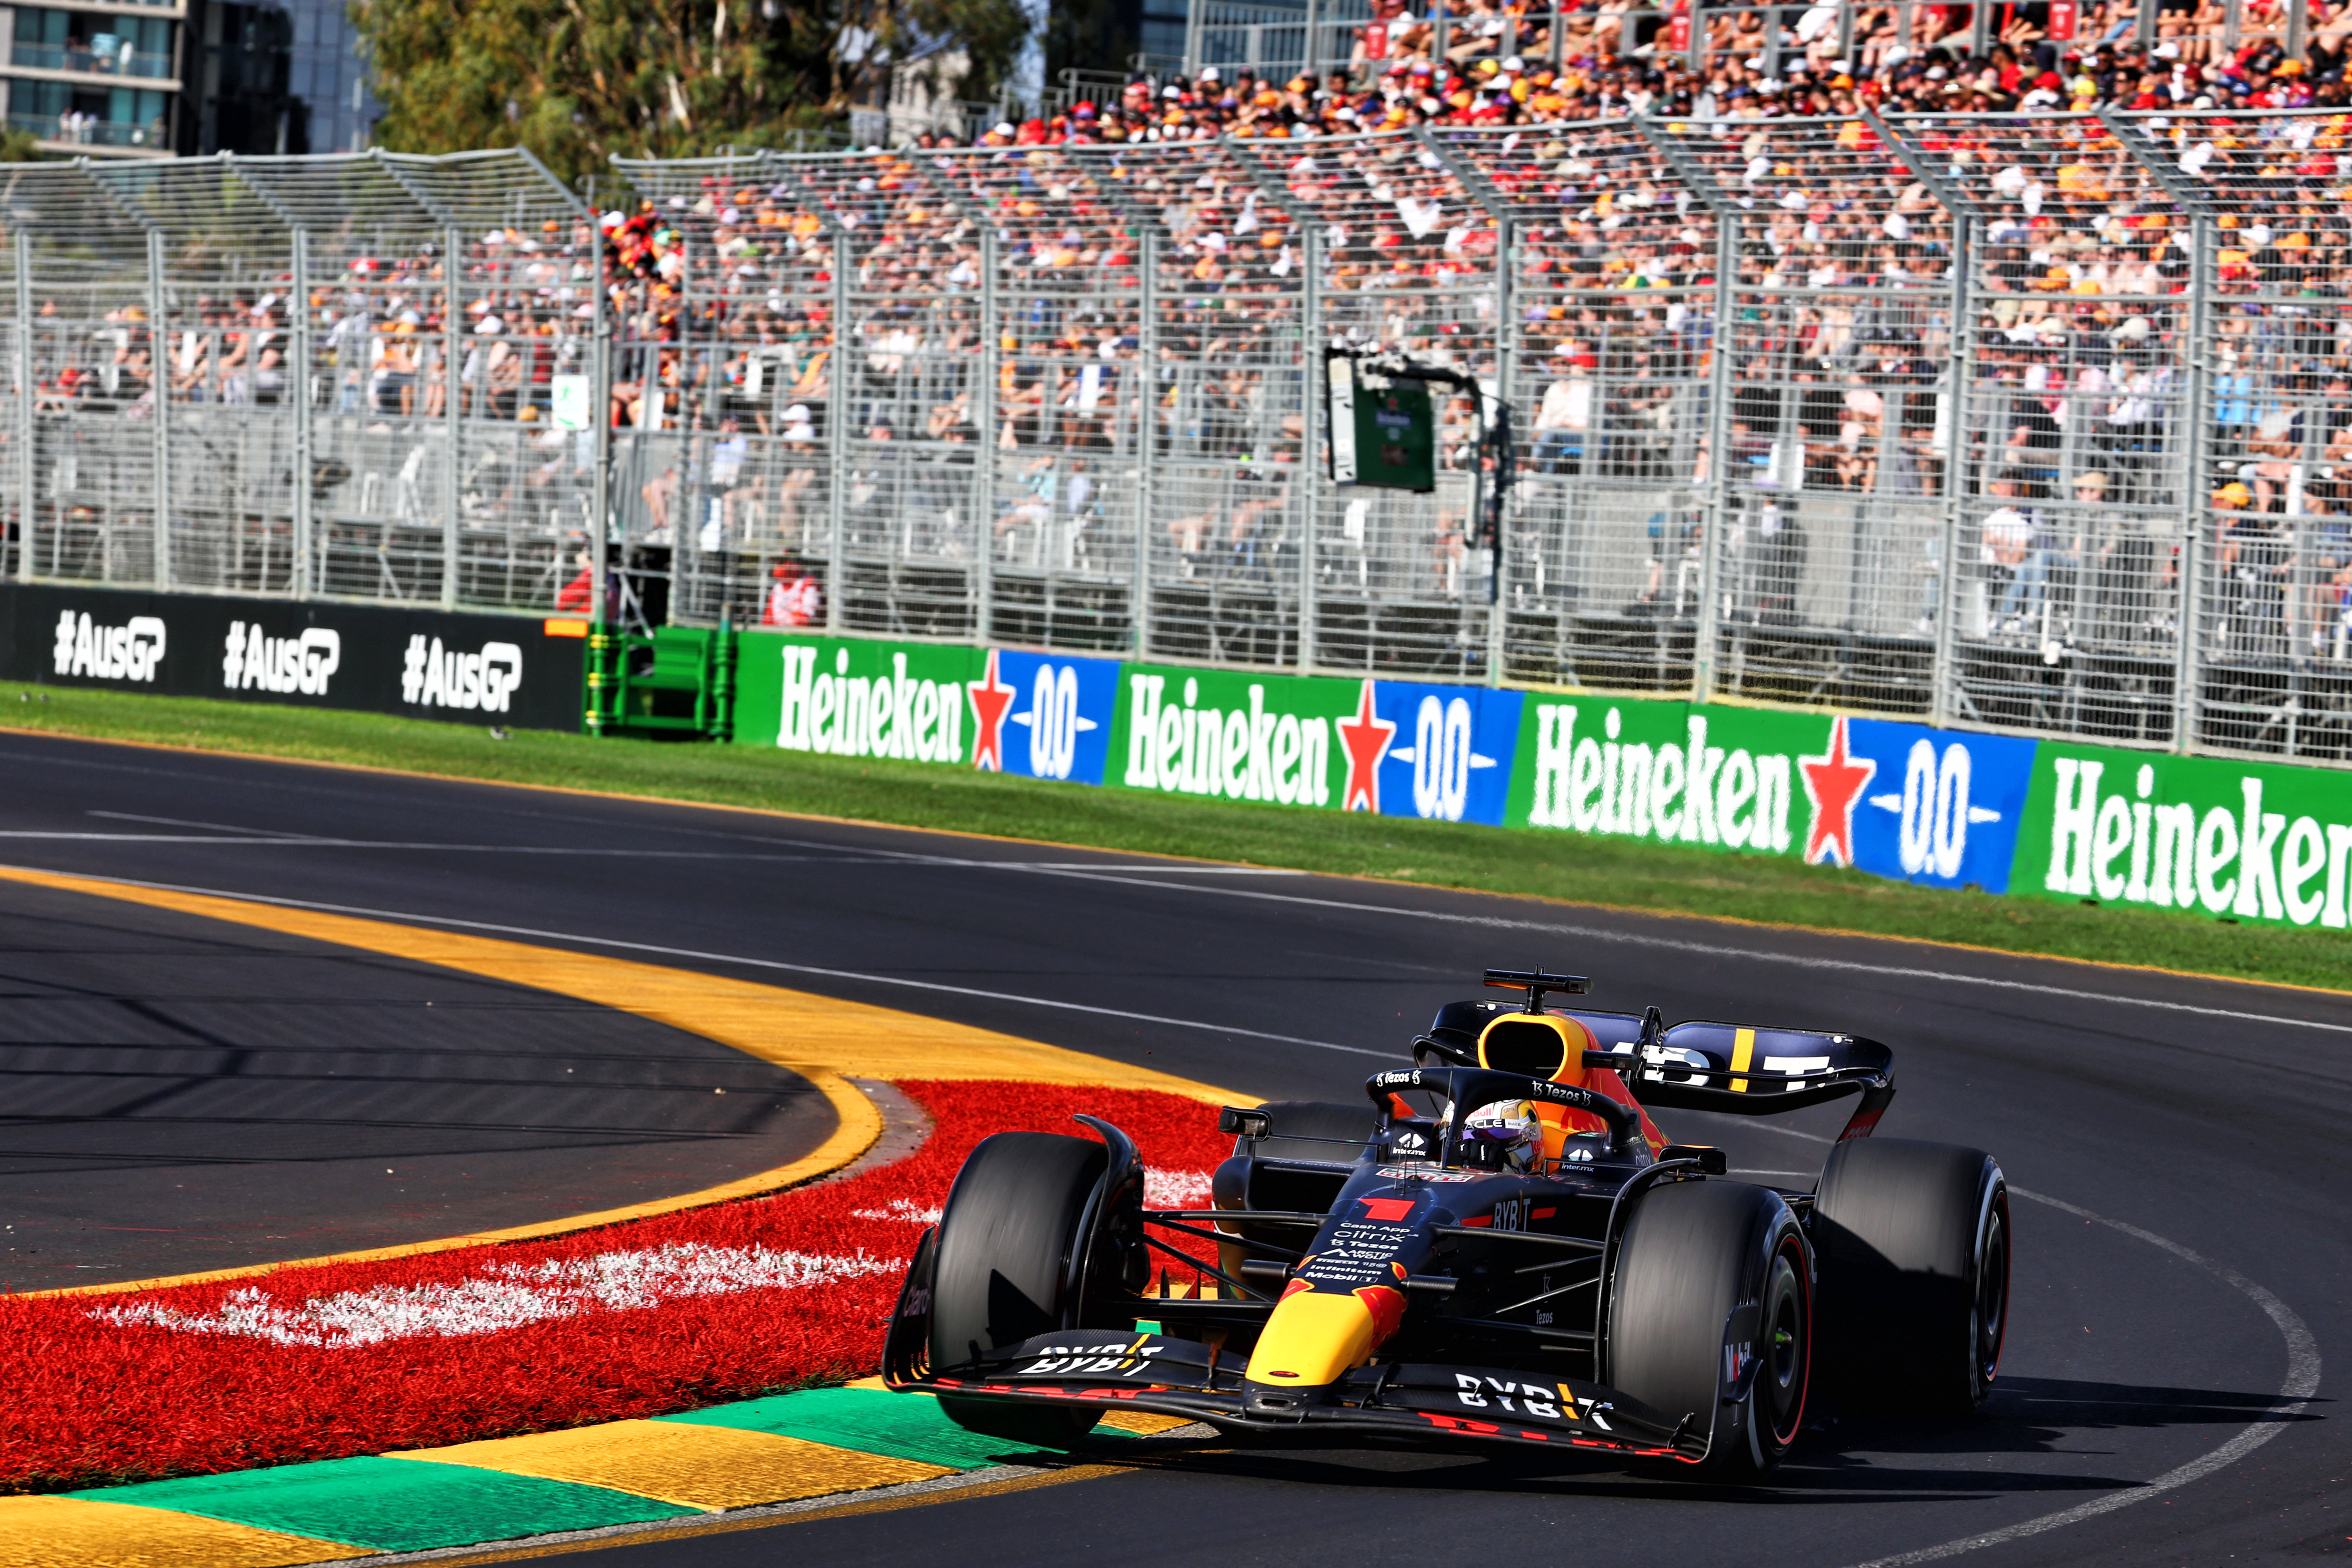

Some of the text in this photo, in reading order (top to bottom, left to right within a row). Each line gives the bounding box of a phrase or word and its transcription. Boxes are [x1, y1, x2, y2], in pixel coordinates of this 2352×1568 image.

[53, 610, 166, 682] #AusGP
[223, 621, 340, 695] #AusGP
[402, 634, 522, 712] #AusGP
[777, 645, 963, 763] Heineken
[1125, 673, 1330, 806] Heineken
[1528, 704, 1793, 853] Heineken
[1385, 1072, 1410, 1083] Tezos
[1545, 1083, 1580, 1101] Tezos
[1462, 1119, 1503, 1131] ACLE
[1392, 1147, 1426, 1156] inter.mx
[1561, 1163, 1594, 1172] inter.mx
[1358, 1198, 1416, 1221] 1
[1349, 1241, 1399, 1250] Tezos
[1305, 1271, 1358, 1281] Mobil
[1310, 1265, 1382, 1275] Infinitum
[1536, 1309, 1553, 1325] Tezos
